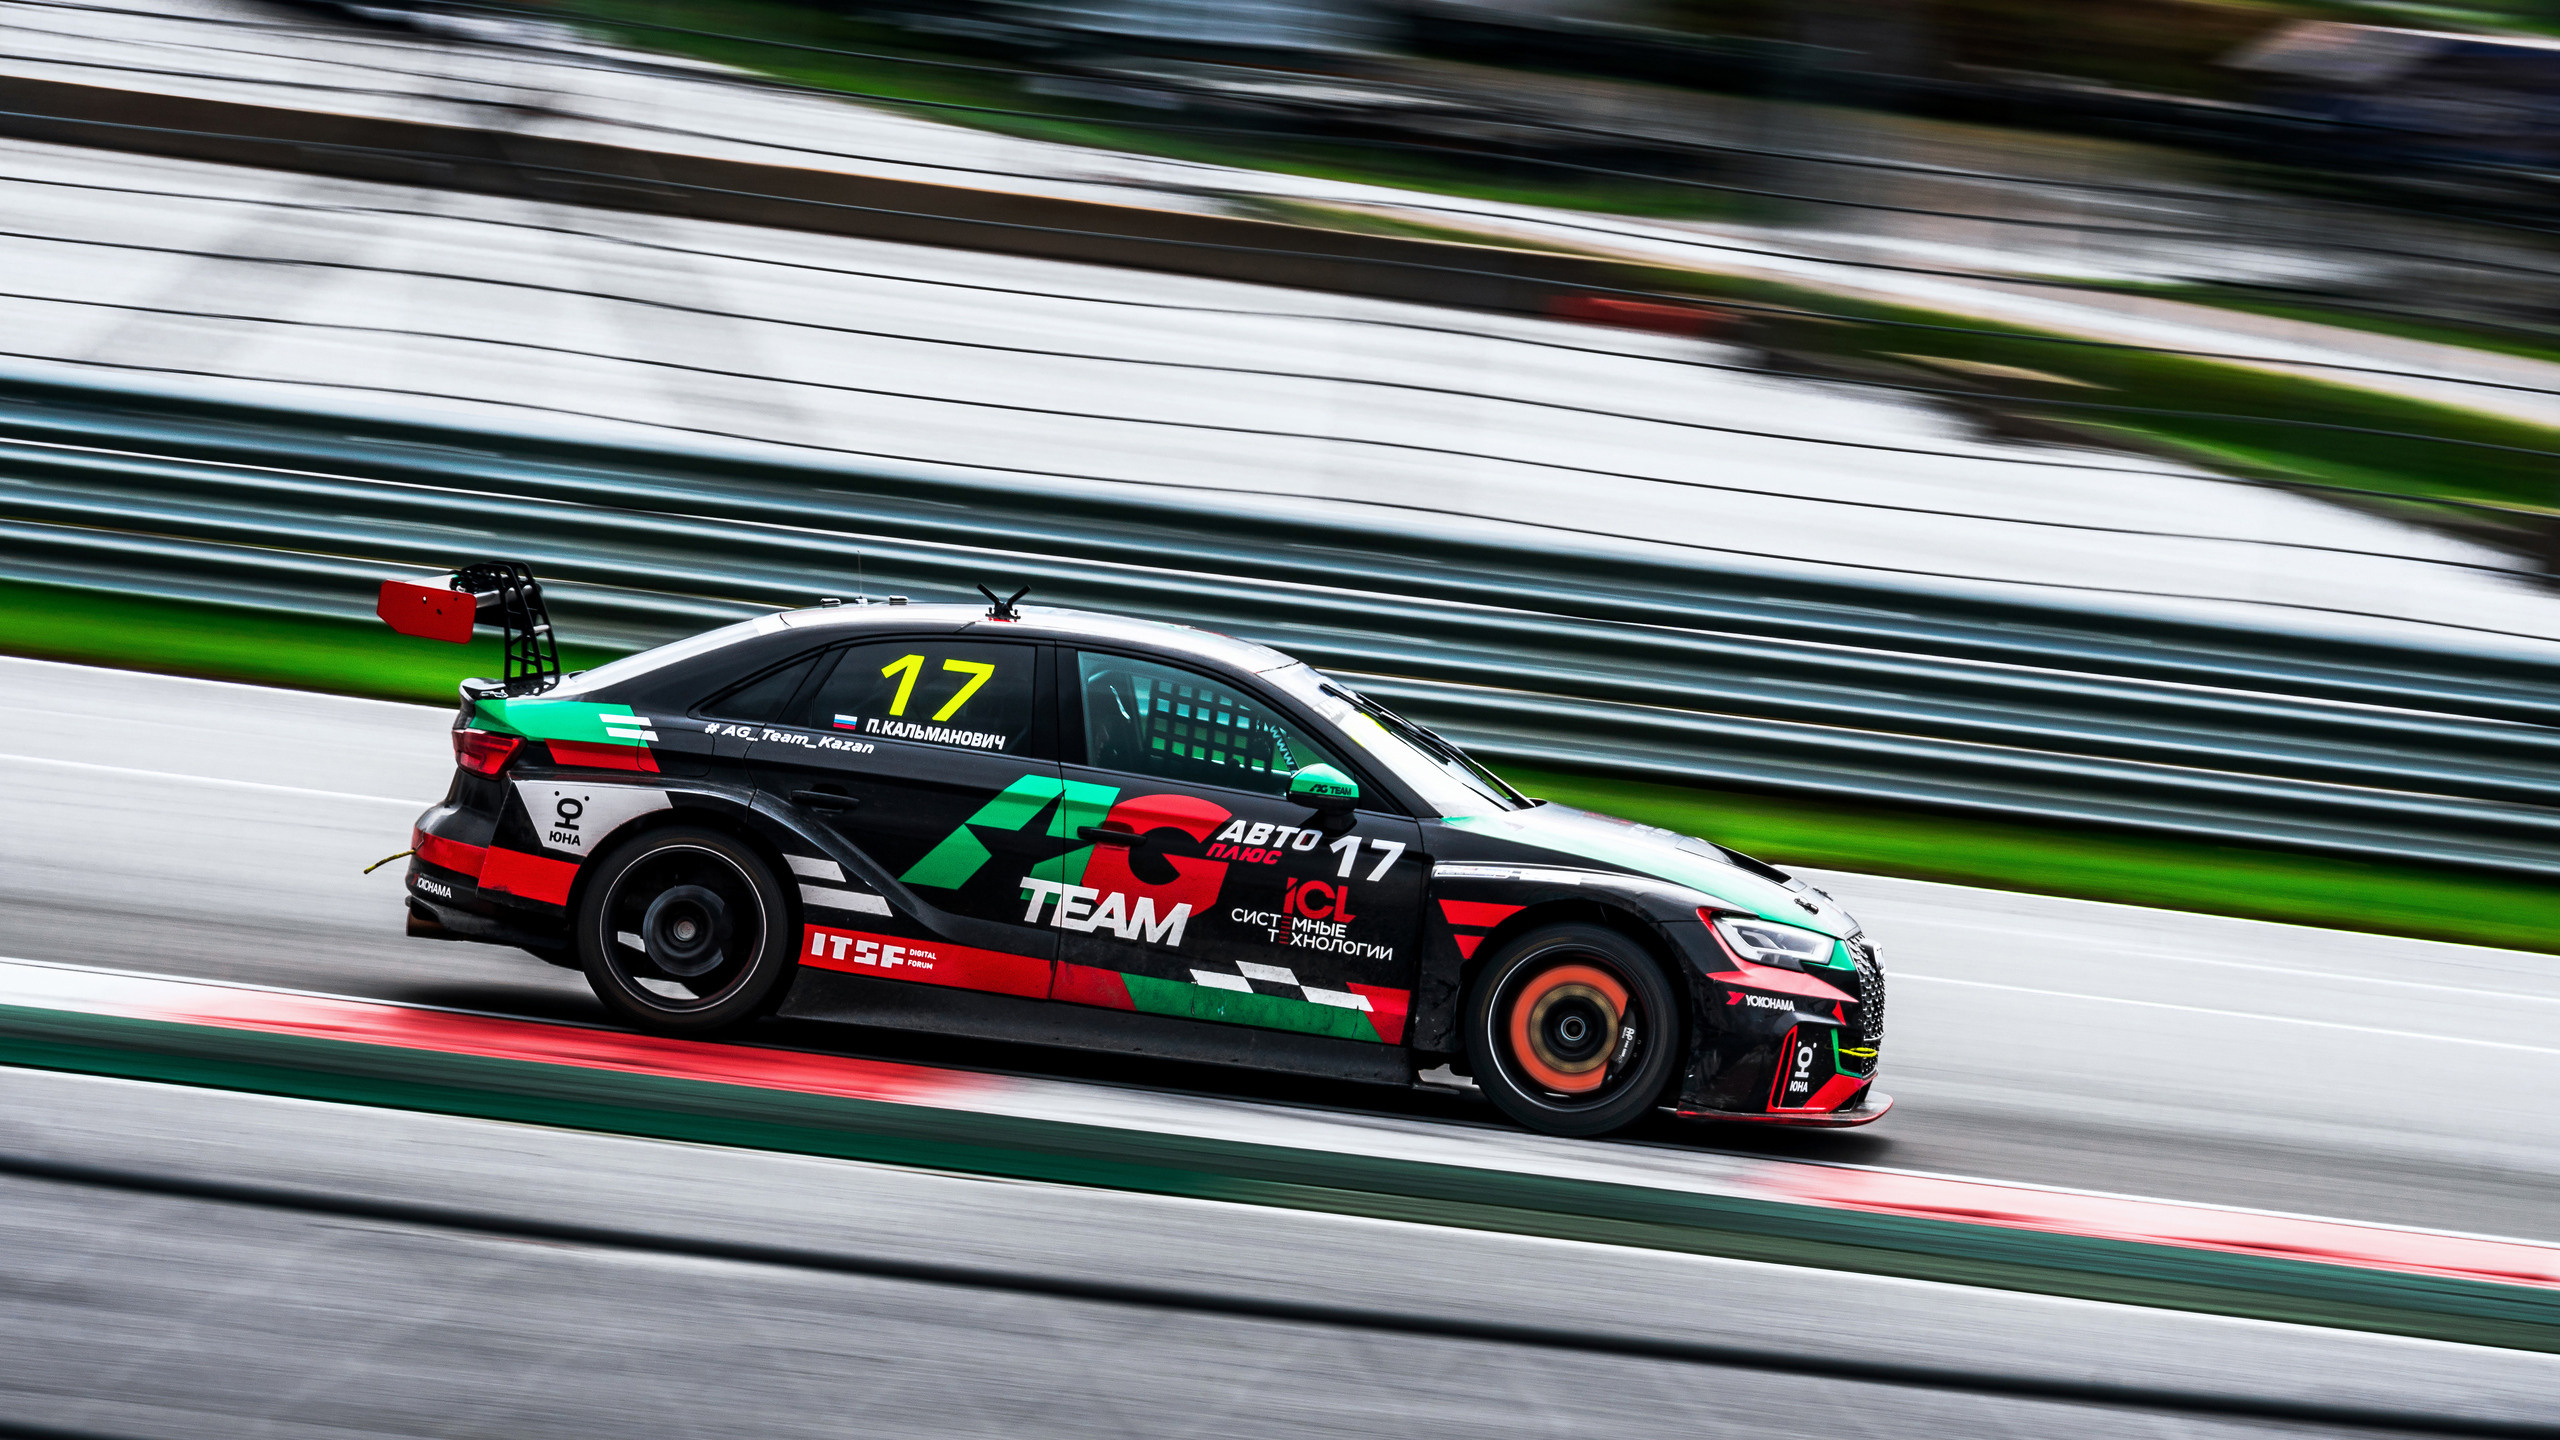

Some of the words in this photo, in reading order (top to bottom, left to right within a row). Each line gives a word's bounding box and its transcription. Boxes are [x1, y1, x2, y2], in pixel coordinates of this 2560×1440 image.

[881, 654, 995, 722] 17
[721, 724, 875, 754] AG_Team_Kazan
[866, 718, 1006, 750] П.КАЛЬМАНОВИЧ
[1330, 786, 1352, 795] TEAM
[549, 831, 581, 847] ЮНА
[1216, 819, 1323, 851] АВТО
[1206, 843, 1282, 865] ПЛЮС
[1329, 835, 1406, 882] 17
[1020, 876, 1192, 946] TEAM
[1283, 877, 1356, 923] ICL
[811, 932, 906, 968] ITSF
[907, 960, 934, 970] FORUM
[909, 948, 937, 960] DIGITAL
[1745, 994, 1795, 1011] YOKOHAMA
[1789, 1080, 1808, 1093] ЮНА
